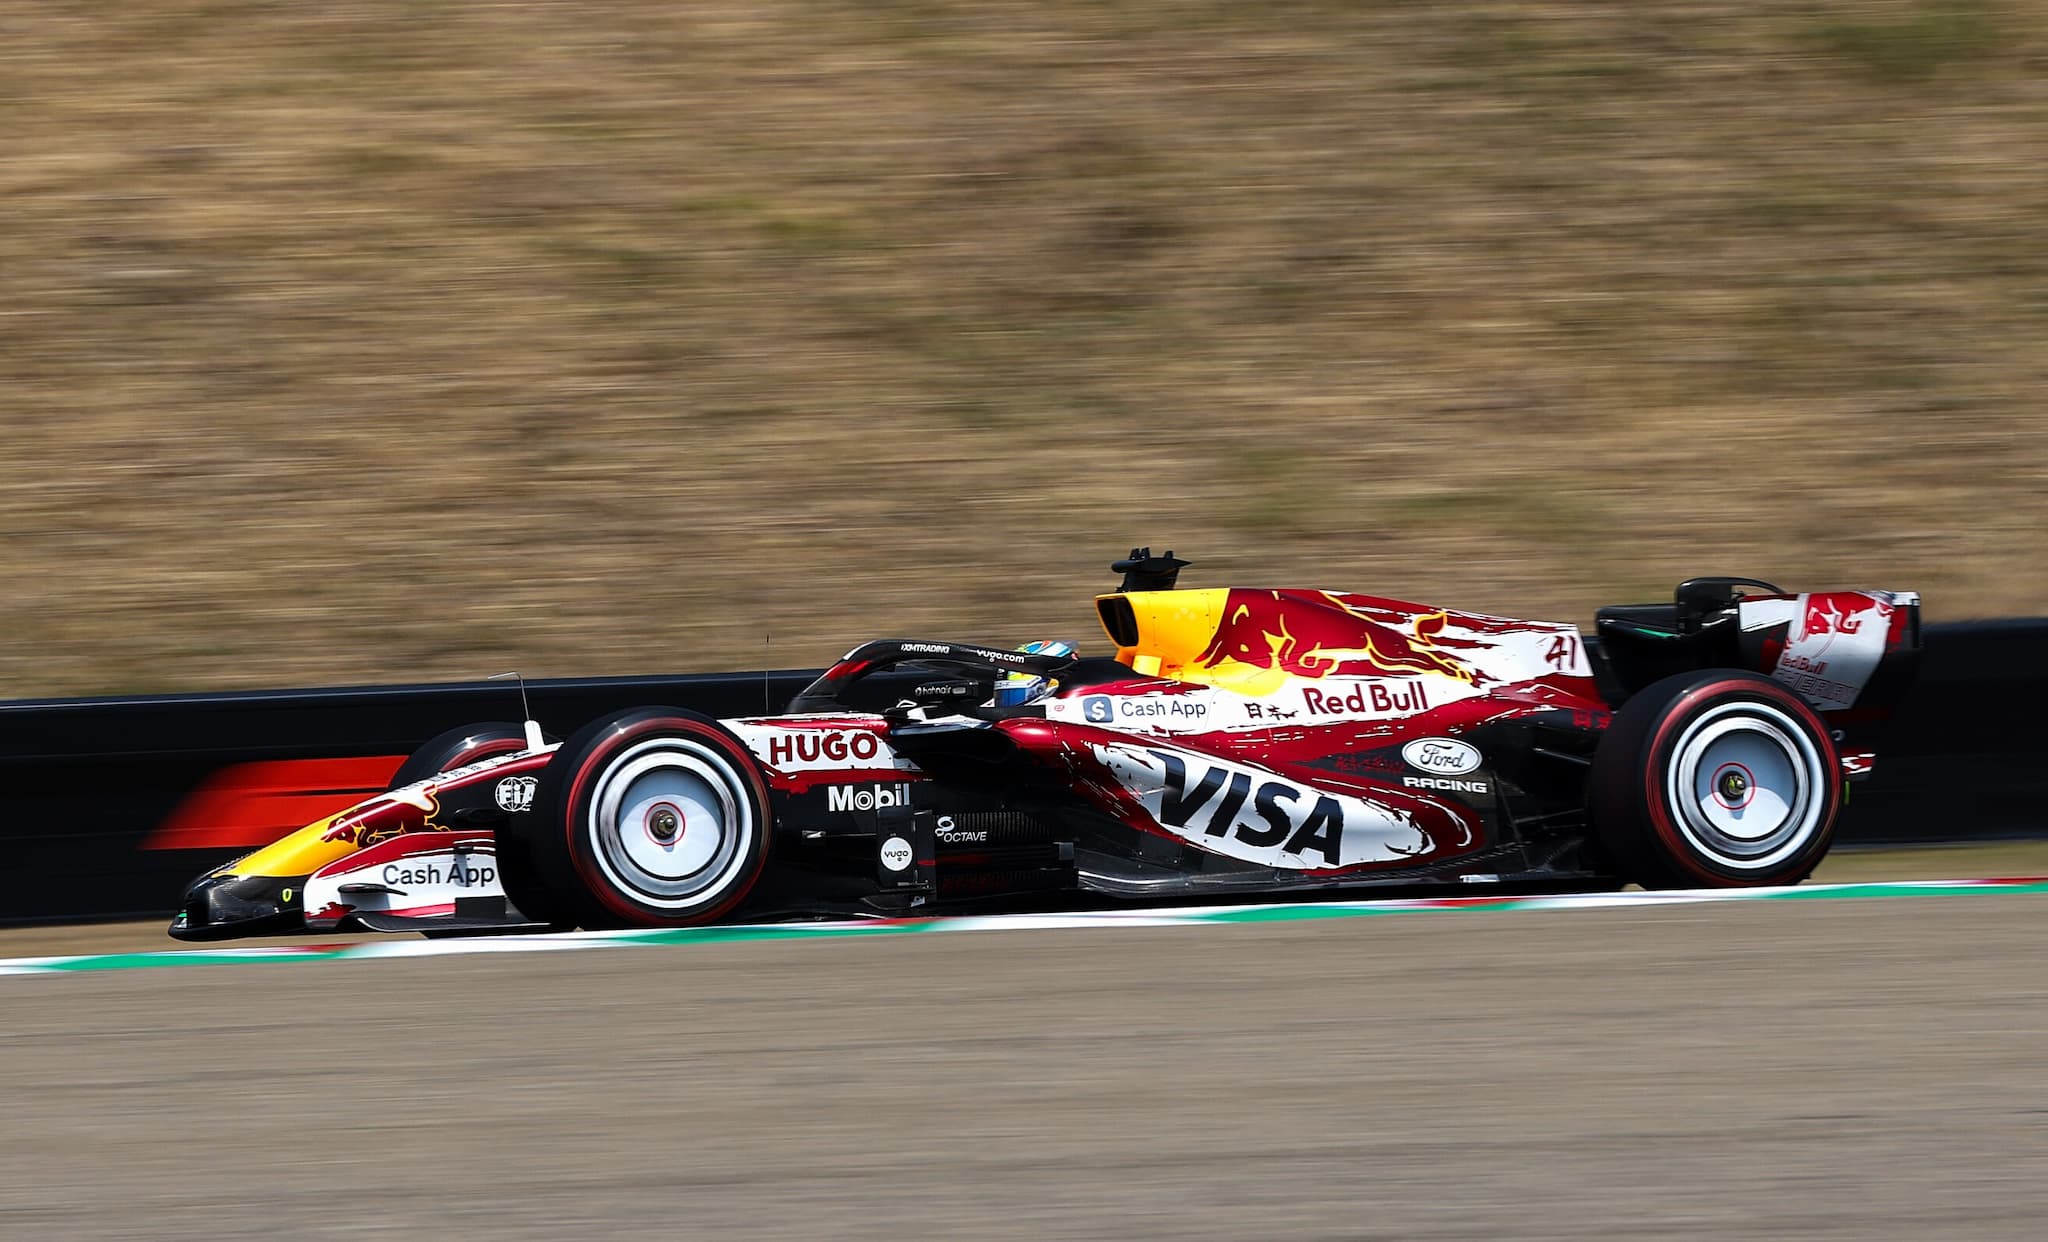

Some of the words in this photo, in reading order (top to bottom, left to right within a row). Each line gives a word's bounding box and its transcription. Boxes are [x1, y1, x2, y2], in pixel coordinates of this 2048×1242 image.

[1545, 635, 1577, 671] 41
[1121, 700, 1166, 717] Cash
[1171, 700, 1206, 719] App
[1302, 683, 1366, 715] Red
[1368, 681, 1428, 712] Bull
[770, 733, 878, 766] HUGO
[1419, 743, 1465, 768] Ford
[828, 783, 910, 812] Mobil
[1402, 776, 1488, 793] RACING
[1146, 749, 1344, 866] VISA
[943, 831, 987, 842] OCTAVE
[383, 864, 440, 885] Cash
[446, 863, 495, 887] App
